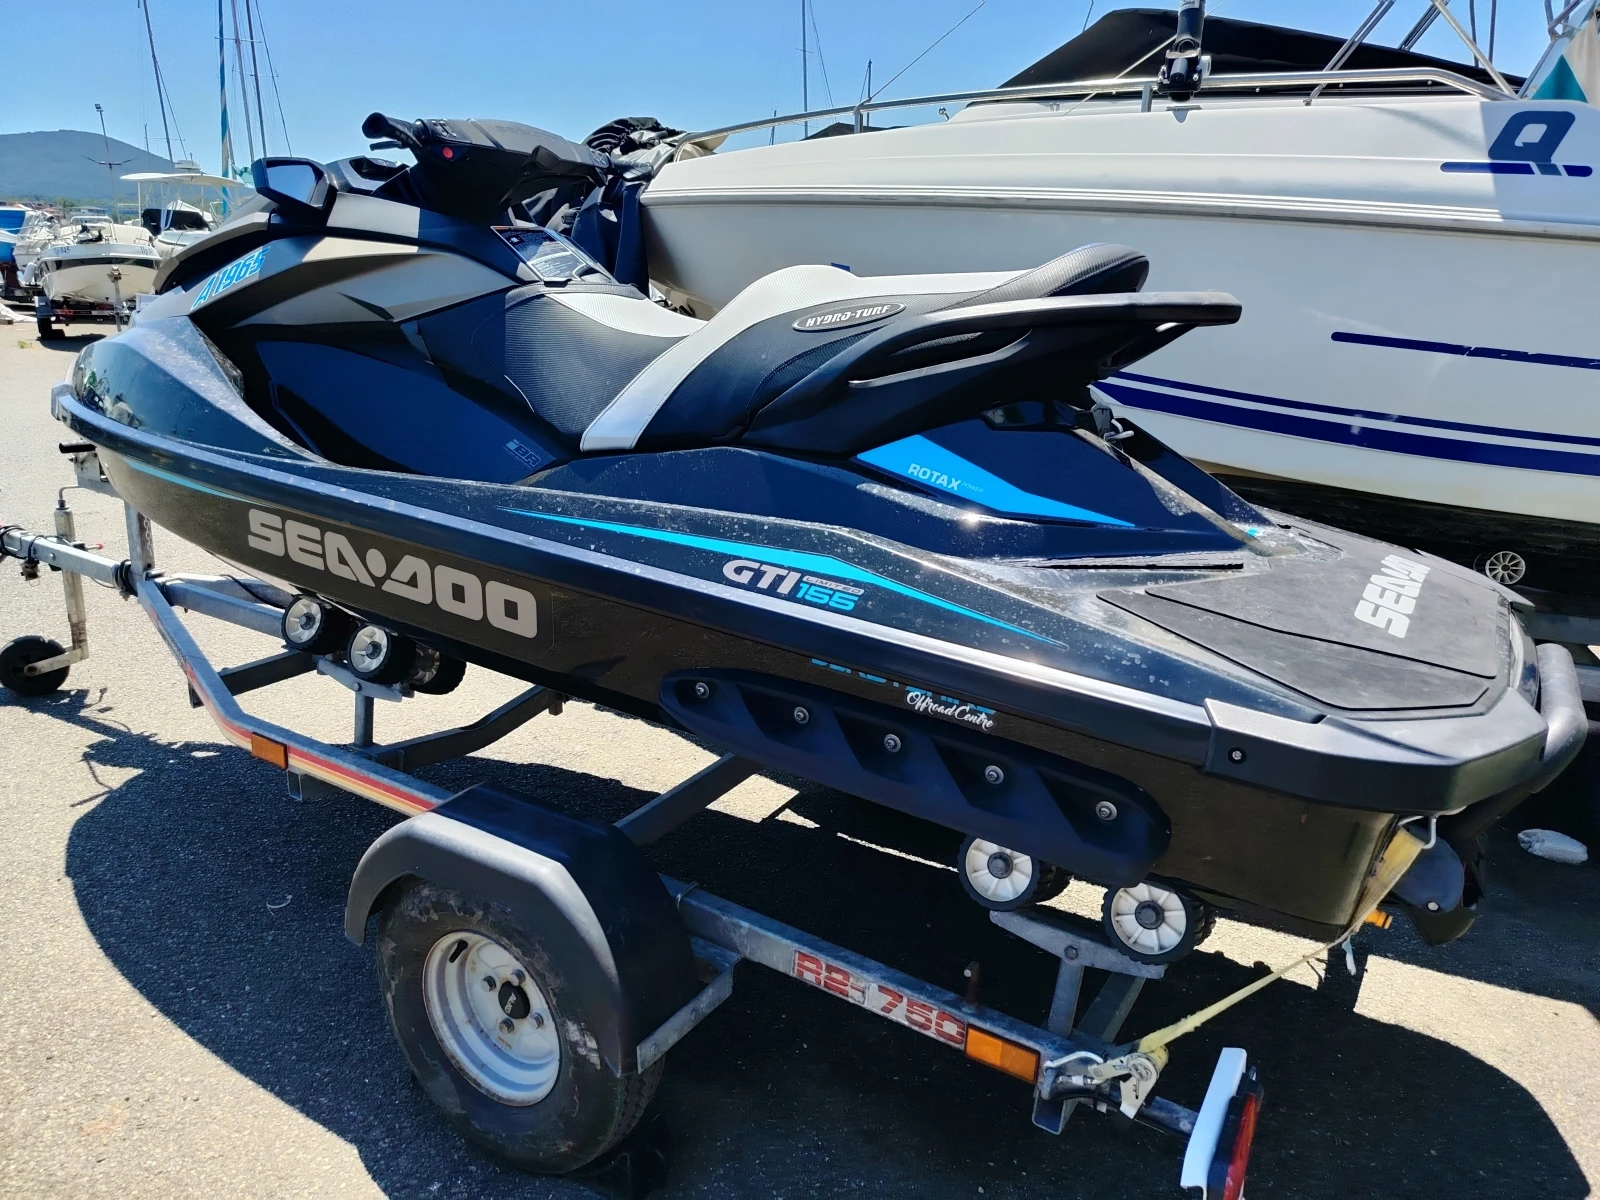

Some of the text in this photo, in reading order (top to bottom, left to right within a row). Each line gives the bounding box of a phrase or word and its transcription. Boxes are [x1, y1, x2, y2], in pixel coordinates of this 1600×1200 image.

[1487, 110, 1576, 177] Q
[804, 304, 891, 328] HYDRO-TURF
[907, 463, 985, 494] ROTAX POWER
[722, 559, 859, 611] GTI 155
[804, 576, 863, 594] LIMITED
[906, 691, 995, 731] Offroad Centre
[877, 984, 967, 1045] 750
